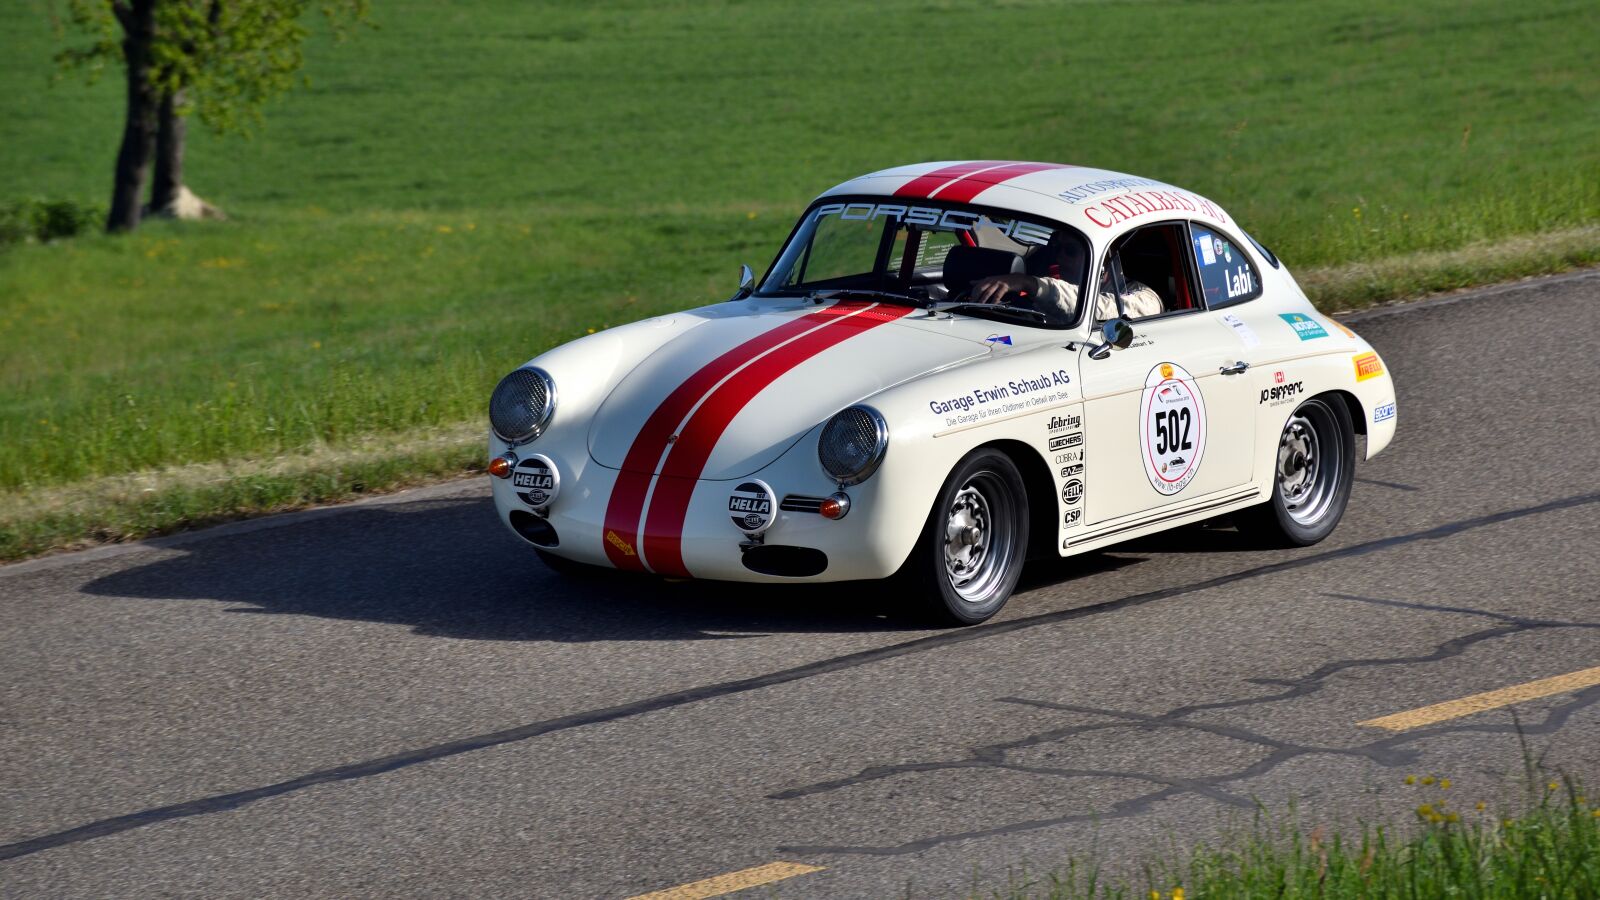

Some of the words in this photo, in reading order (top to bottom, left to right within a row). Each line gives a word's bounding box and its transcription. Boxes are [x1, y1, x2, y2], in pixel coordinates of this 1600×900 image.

[1084, 191, 1197, 229] CATALBAS
[813, 203, 1054, 246] PORSCHE
[1224, 263, 1253, 298] Labi
[1356, 354, 1383, 377] PIRELLI
[929, 395, 975, 415] Garage
[973, 385, 1010, 404] Erwin
[1008, 374, 1052, 396] Schaub
[1052, 369, 1071, 386] AG
[957, 413, 979, 423] Garage
[1046, 414, 1082, 431] Sebring
[1155, 406, 1192, 456] 502
[1050, 435, 1082, 449] WIECHERS
[1055, 451, 1078, 465] COBRA
[514, 473, 553, 488] HELLA
[1063, 483, 1083, 499] HELLA
[729, 497, 770, 513] HELLA
[1064, 509, 1081, 524] CSP
